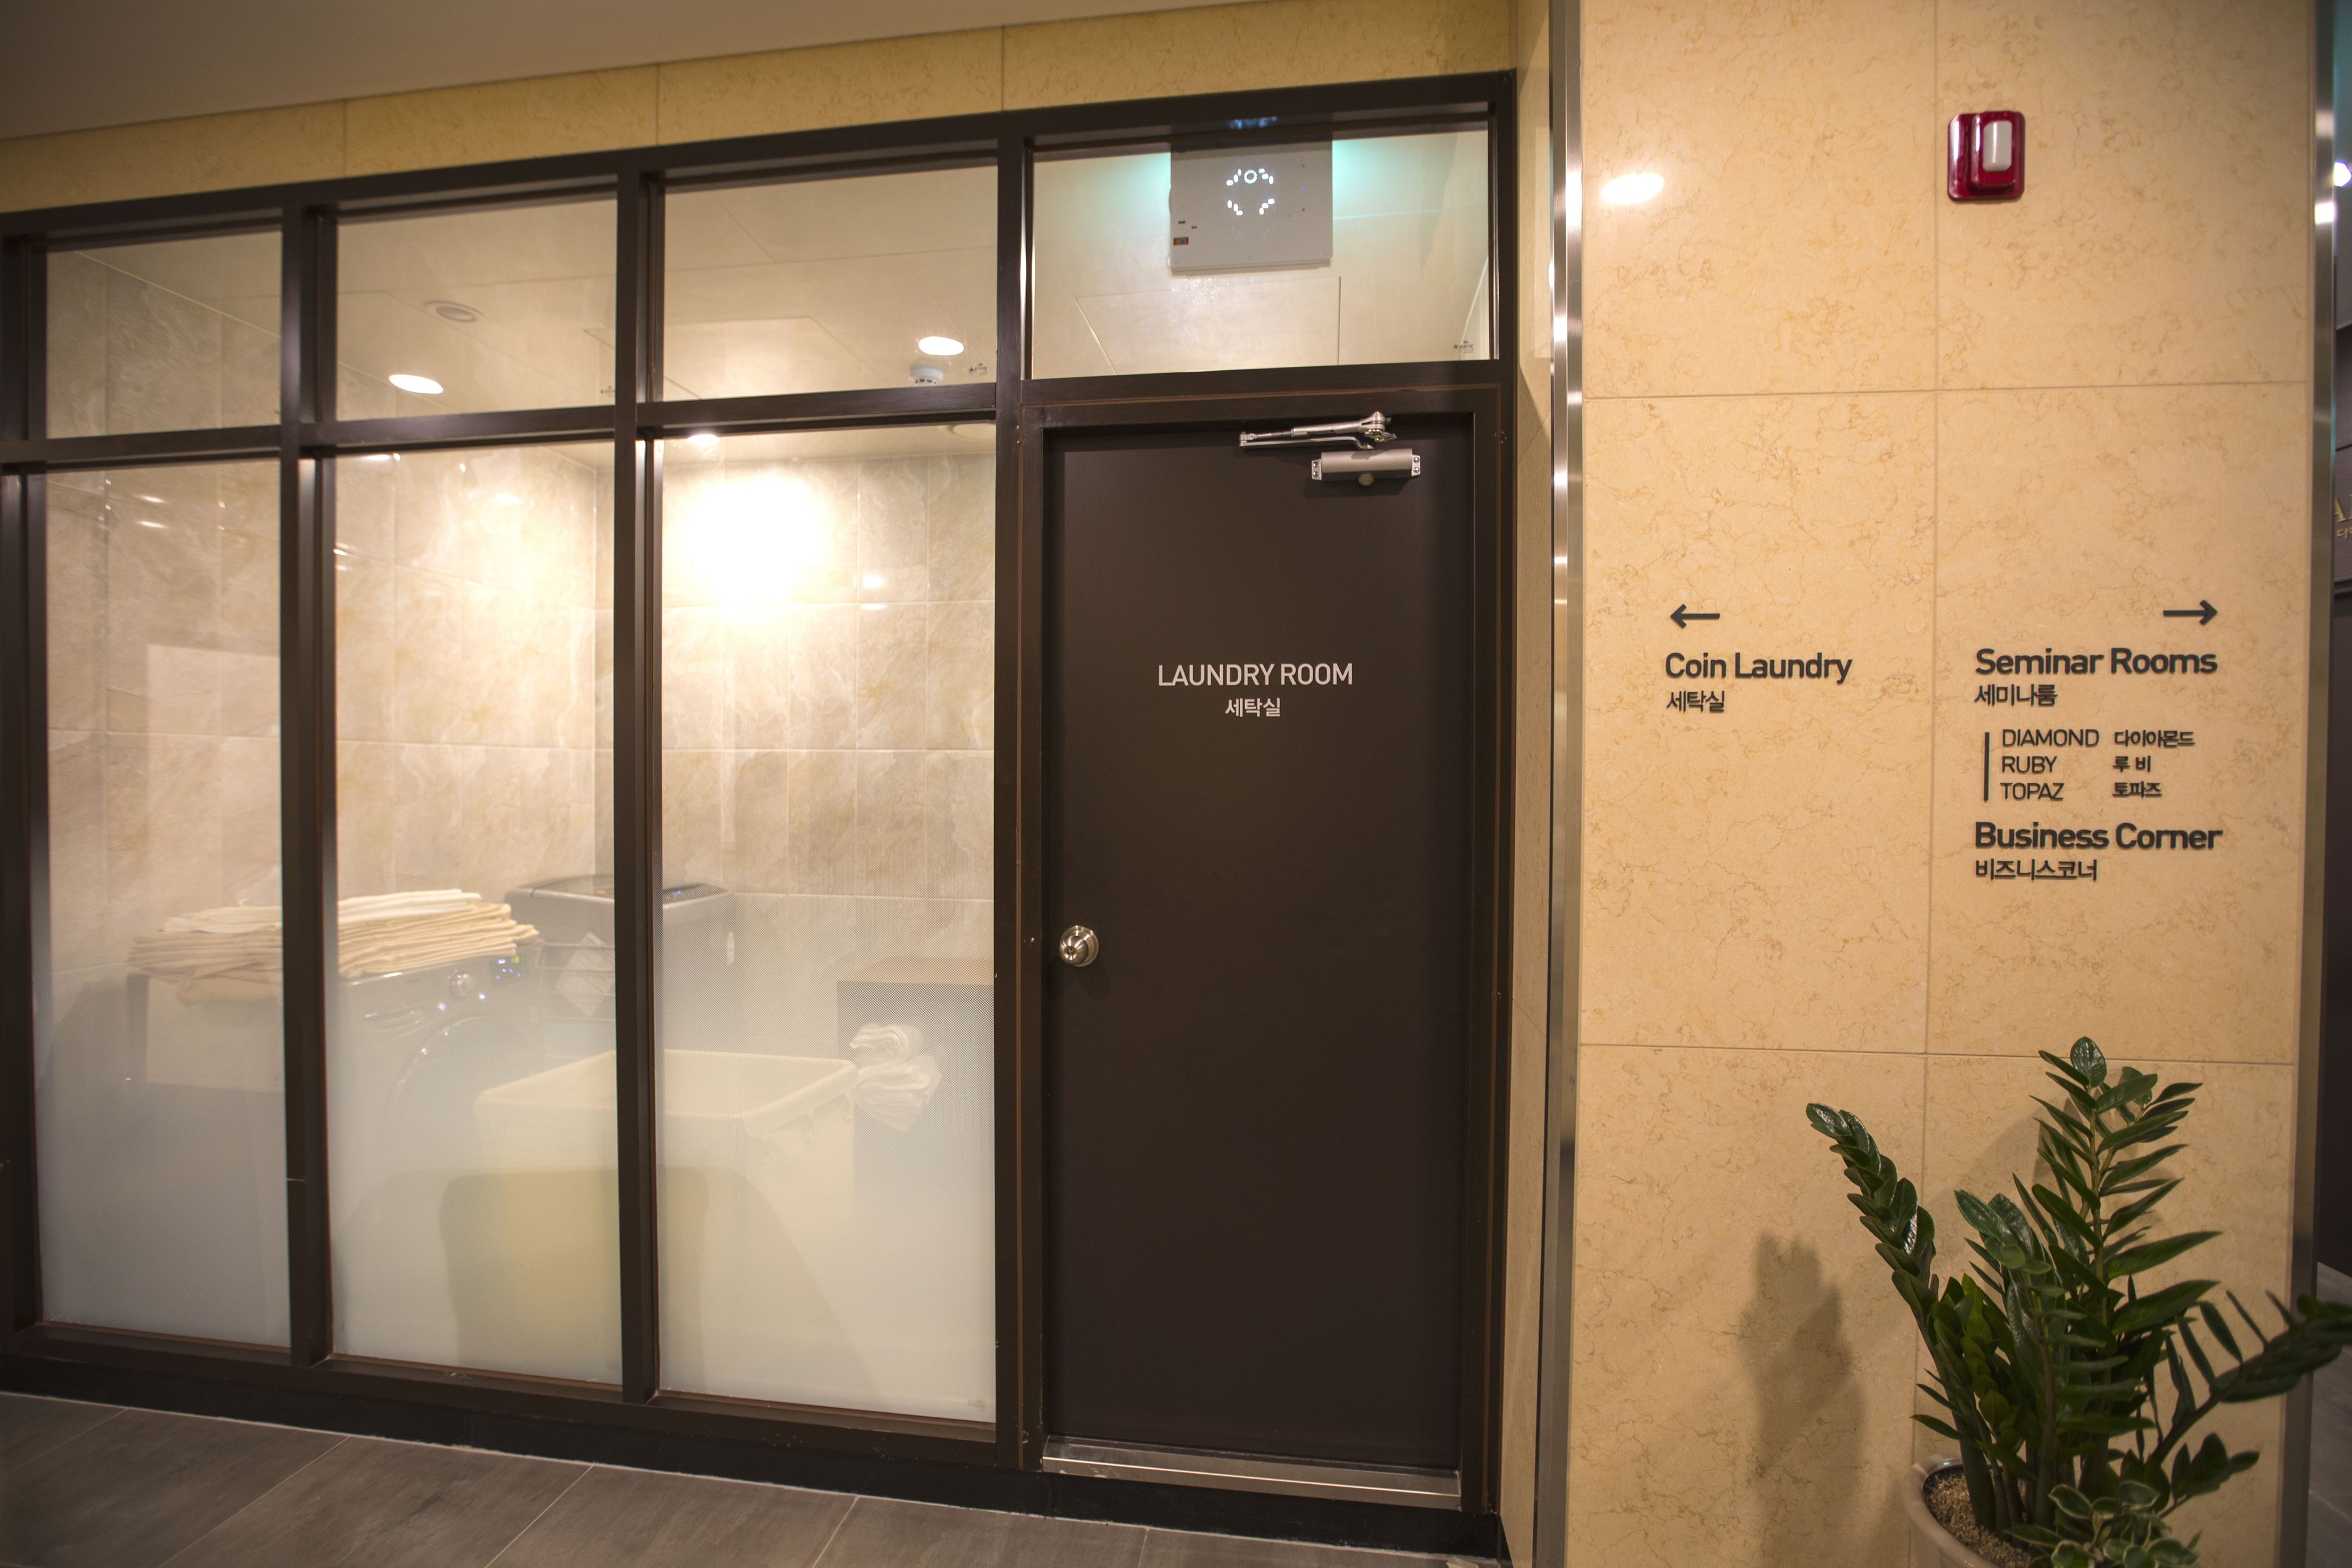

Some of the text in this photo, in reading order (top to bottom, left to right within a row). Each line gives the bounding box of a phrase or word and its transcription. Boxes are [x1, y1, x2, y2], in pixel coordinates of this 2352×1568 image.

[1665, 652, 1853, 685] Coin Laundry
[1975, 647, 2218, 676] Seminar Rooms
[1158, 663, 1353, 687] LAUNDRY ROOM
[1666, 690, 1725, 714] 세탁실
[1974, 684, 2058, 707] 세미나룸
[1225, 698, 1281, 717] 세탁실
[2002, 729, 2100, 748] DIAMOND
[2114, 729, 2196, 748] 다이아몬드
[2001, 756, 2057, 775] RUBY
[2000, 782, 2065, 802] TOPAZ
[2112, 780, 2163, 799] 토파즈
[1975, 821, 2224, 851] Business Corner
[1975, 858, 2097, 881] 비즈니스코너
